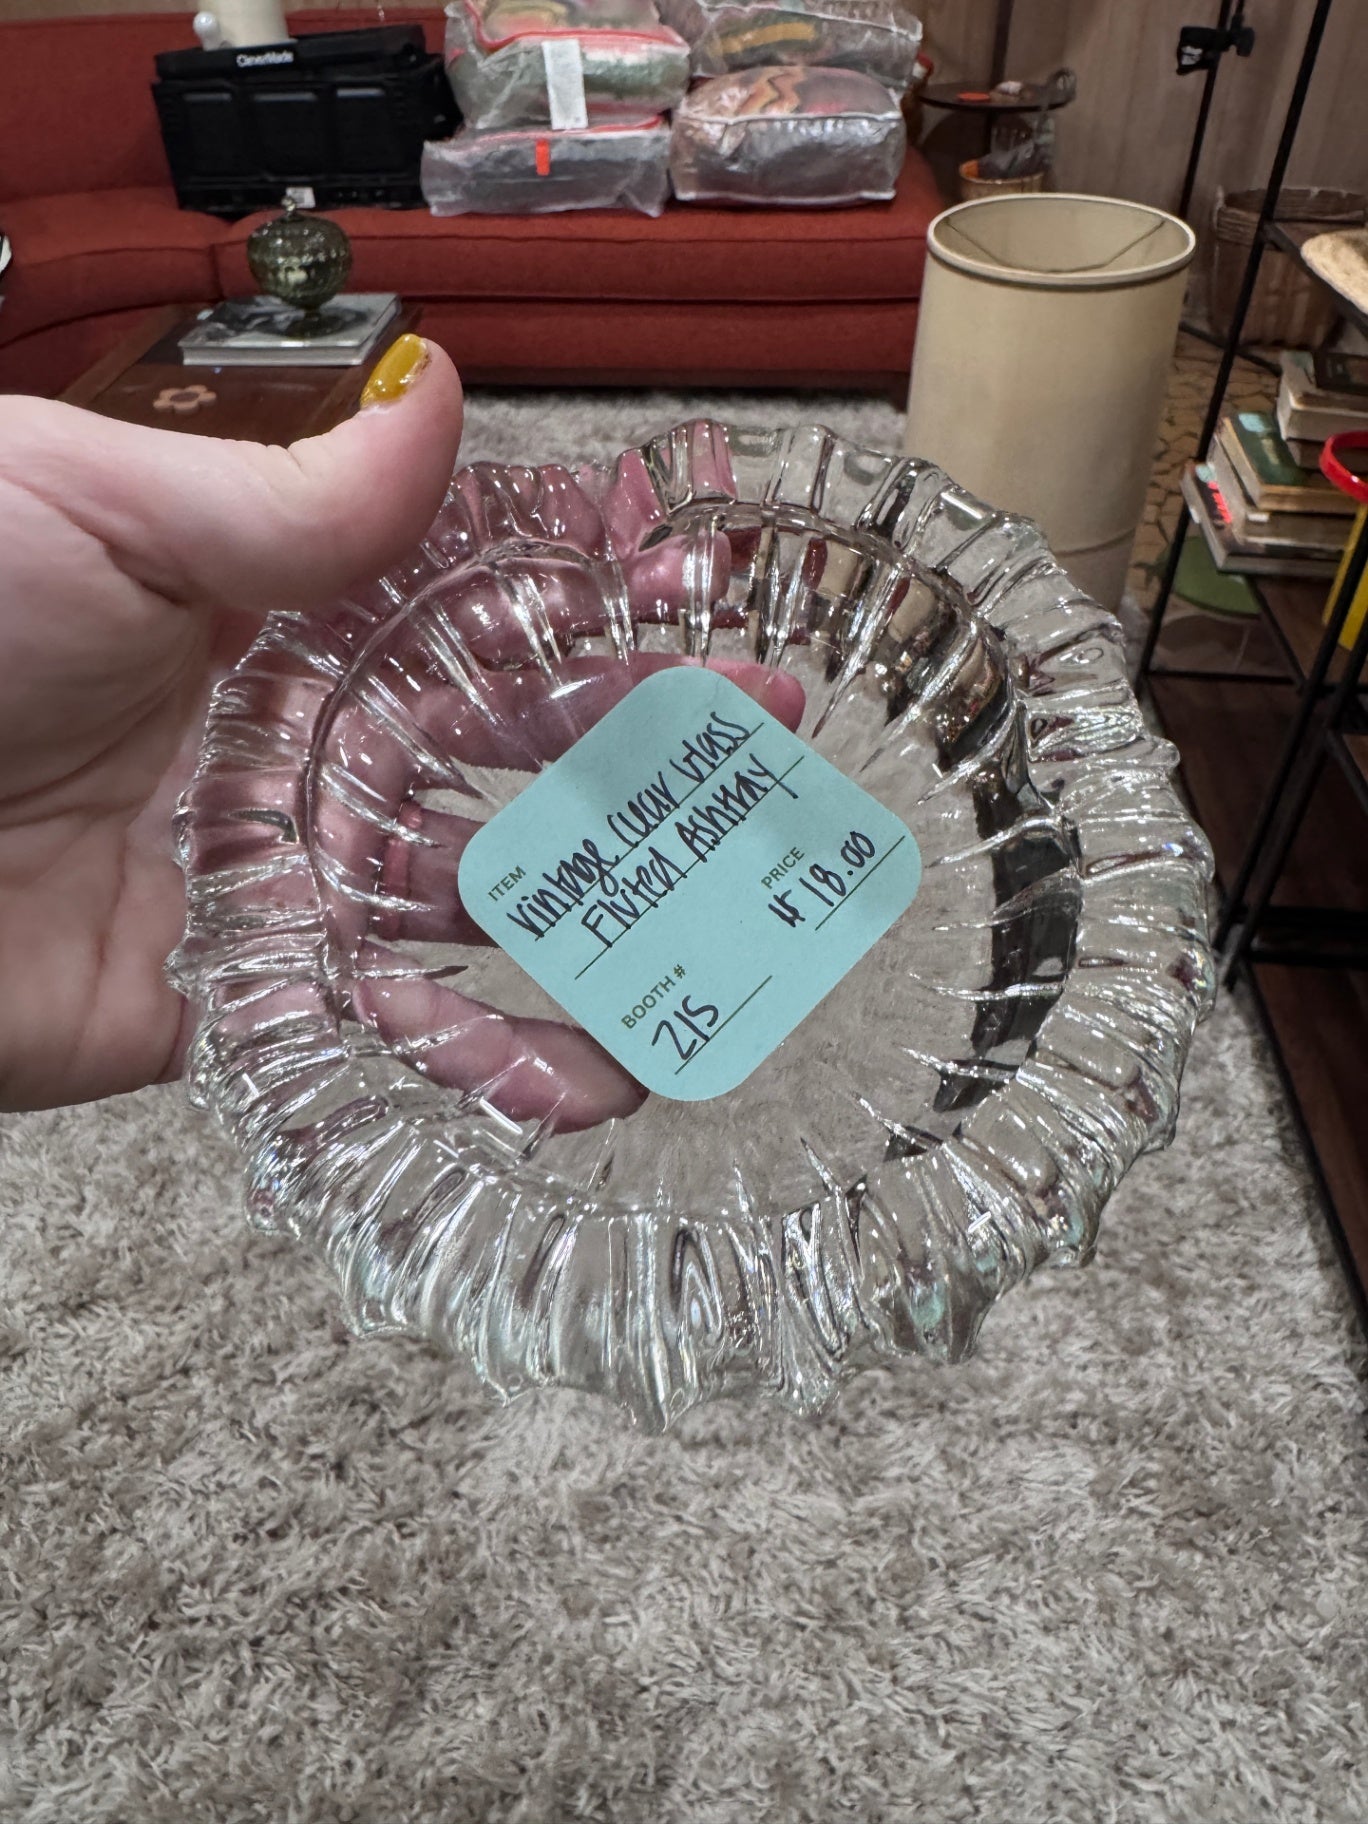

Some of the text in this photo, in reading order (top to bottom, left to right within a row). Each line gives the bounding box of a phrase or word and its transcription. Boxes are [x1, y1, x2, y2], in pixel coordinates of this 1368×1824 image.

[487, 865, 527, 902] ITEM
[581, 752, 800, 949] Fluted Ashtray
[760, 846, 806, 890] PRICE
[621, 963, 687, 1030] BOOTH #
[651, 994, 720, 1061] 215
